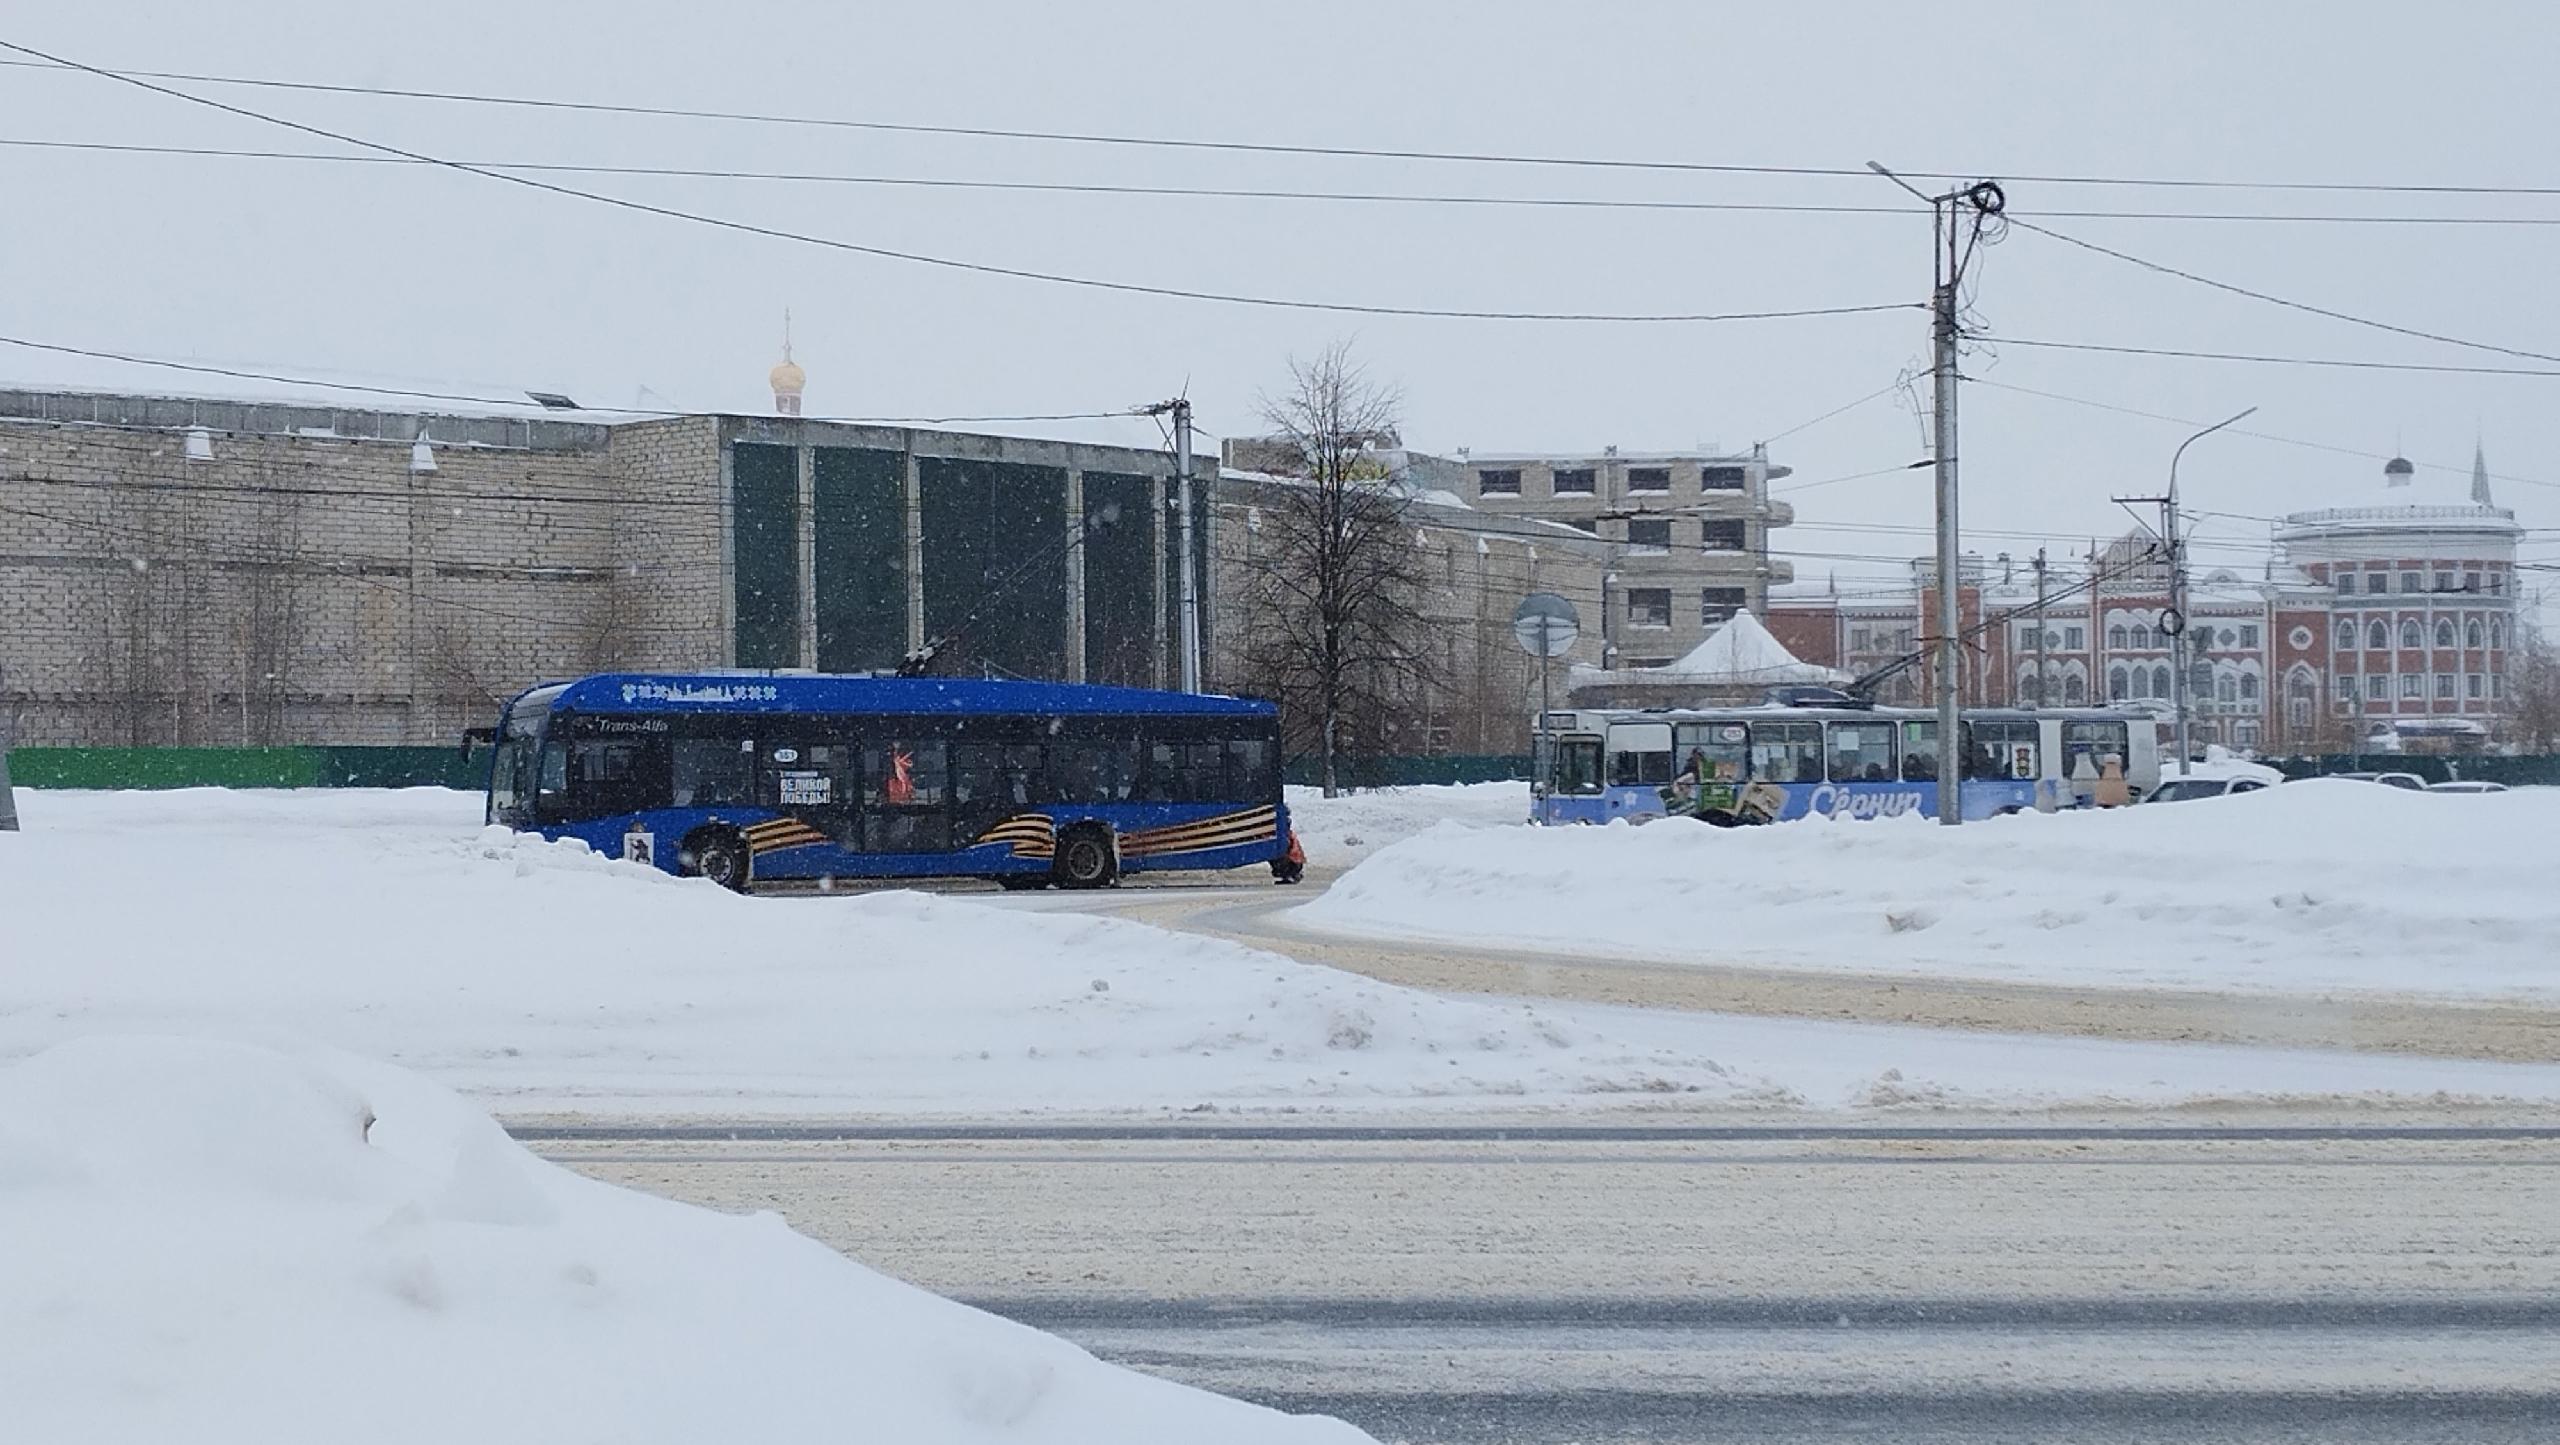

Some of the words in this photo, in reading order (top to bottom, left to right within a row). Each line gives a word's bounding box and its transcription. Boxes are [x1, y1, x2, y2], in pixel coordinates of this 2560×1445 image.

[599, 719, 669, 732] Trans-Alfa
[780, 777, 831, 791] ВЕЛИКОЙ
[780, 791, 831, 805] ПОБЕДЫ!
